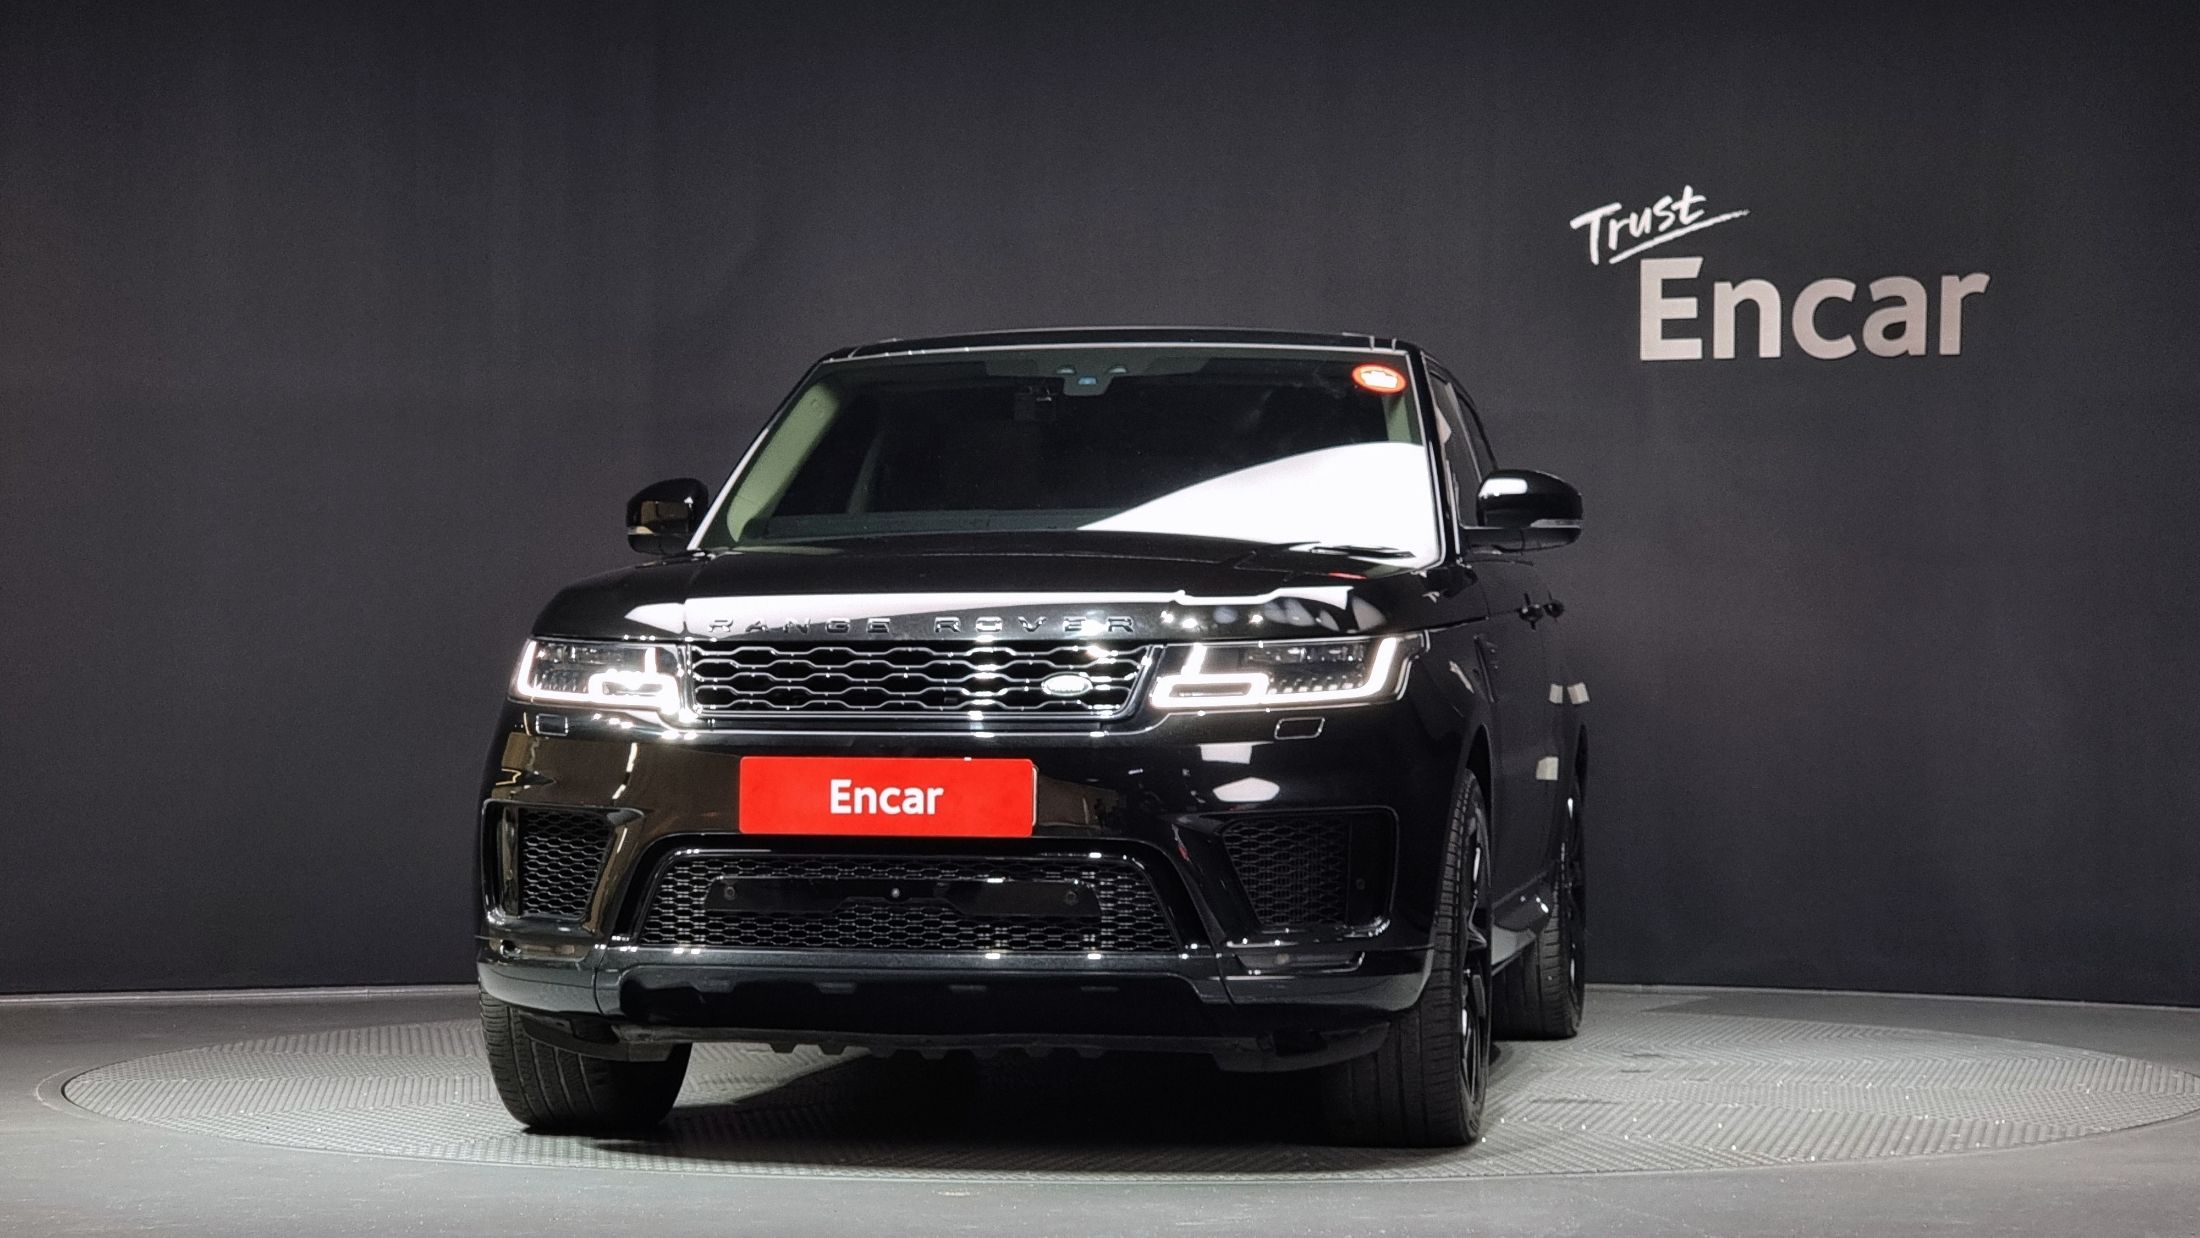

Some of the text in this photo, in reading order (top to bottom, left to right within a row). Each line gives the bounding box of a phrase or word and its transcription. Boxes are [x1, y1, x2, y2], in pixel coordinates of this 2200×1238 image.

[1569, 184, 1707, 265] Trust
[1639, 256, 1991, 361] Encar
[708, 615, 1136, 634] RANGE ROVER
[829, 778, 944, 815] Encar
